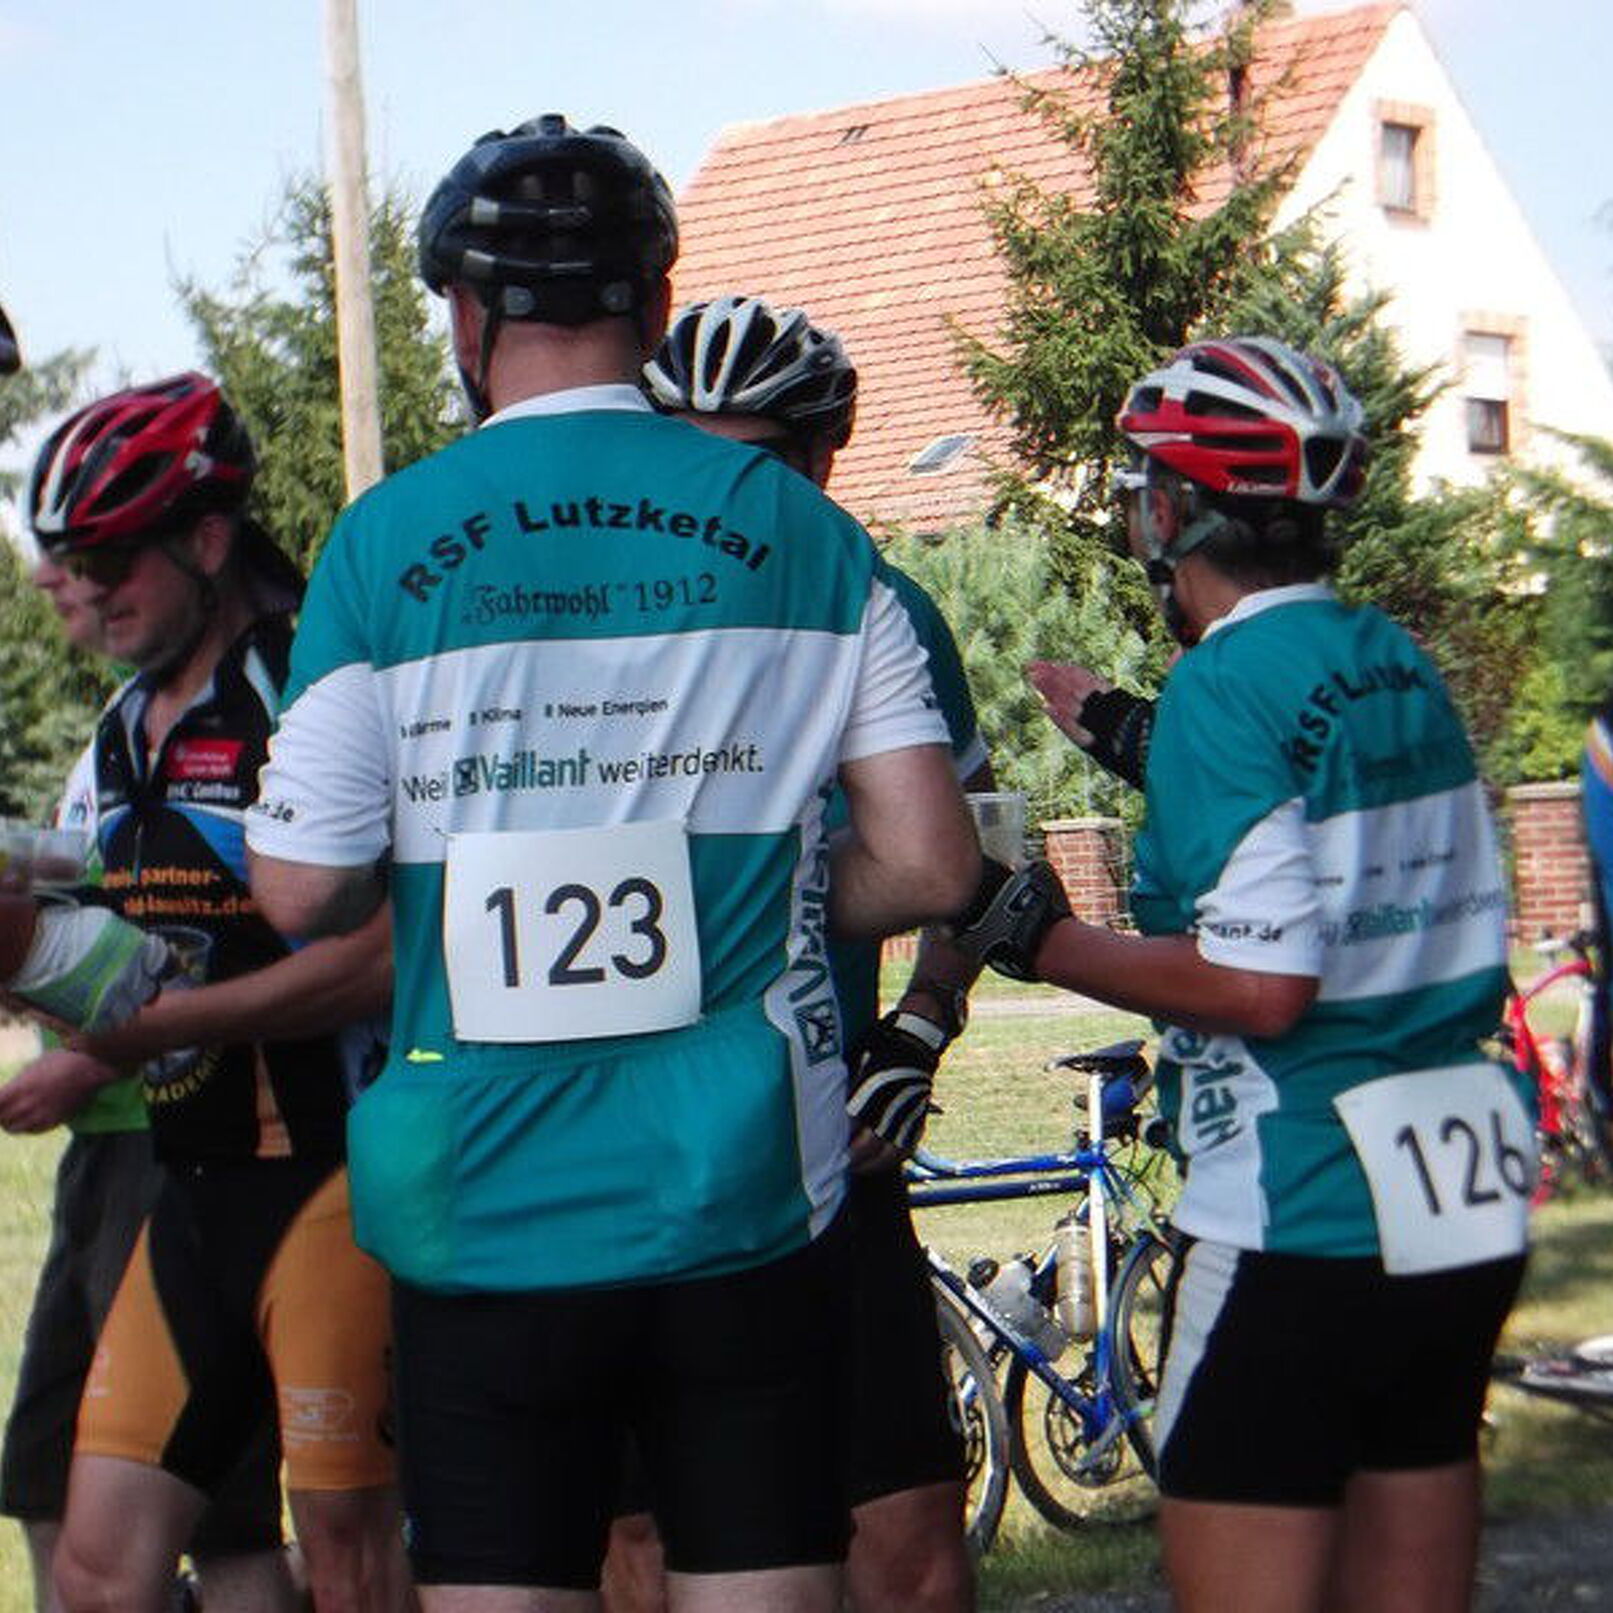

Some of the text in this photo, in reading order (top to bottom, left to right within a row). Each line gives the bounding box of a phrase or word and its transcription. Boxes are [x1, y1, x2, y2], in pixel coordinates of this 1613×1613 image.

[399, 497, 770, 604] RSF Lutzketal
[635, 572, 718, 612] 1912
[557, 698, 669, 719] Neue Energien
[480, 748, 591, 792] Vaillant
[599, 742, 764, 784] weiterdenkt.
[485, 876, 667, 988] 123
[1395, 1109, 1531, 1217] 126
